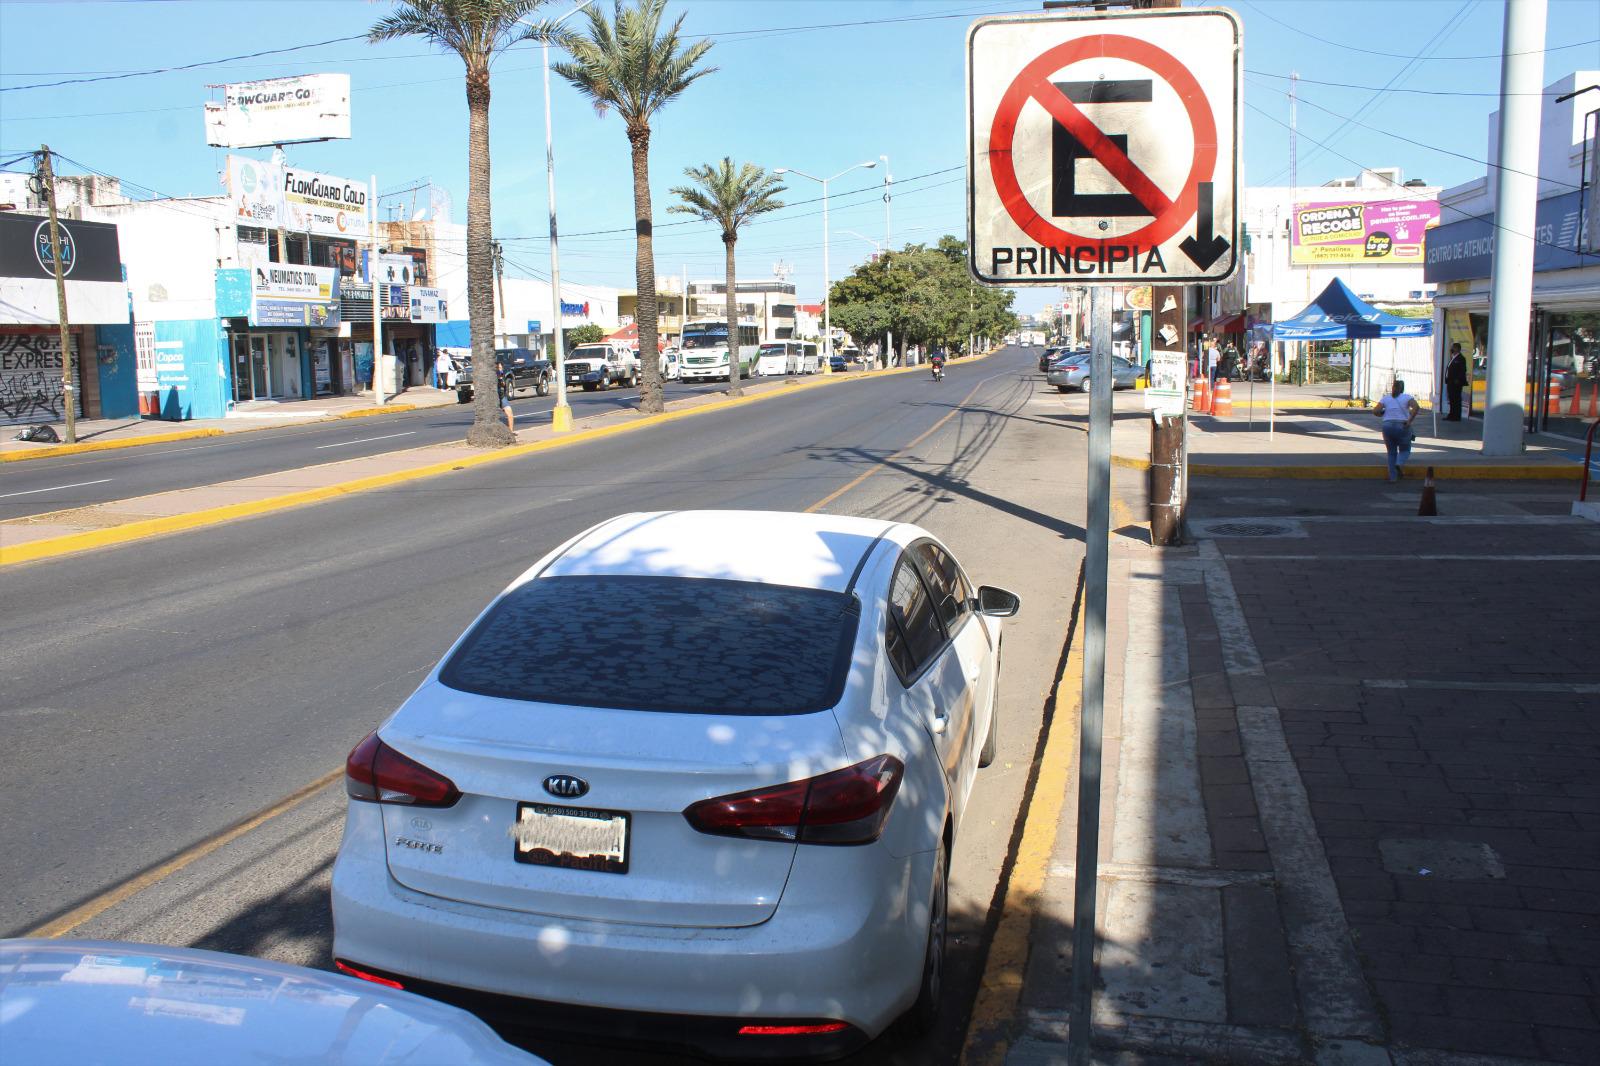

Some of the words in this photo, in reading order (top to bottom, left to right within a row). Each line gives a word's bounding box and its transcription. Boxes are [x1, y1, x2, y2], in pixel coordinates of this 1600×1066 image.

[314, 213, 334, 224] TRUPER
[1301, 207, 1349, 223] ORDENA
[1352, 207, 1361, 217] Y
[1302, 218, 1361, 235] RECOGE
[39, 234, 69, 245] SUHI
[1369, 236, 1390, 244] Pana
[1377, 243, 1389, 251] go
[40, 243, 71, 260] KM
[1428, 246, 1452, 265] CENTRO
[1453, 242, 1463, 260] DE
[1464, 232, 1495, 257] ATENCIÓ
[991, 245, 1167, 275] PRINCIPIA
[270, 269, 302, 285] NEUMATICS
[304, 272, 318, 286] TOOL
[1324, 313, 1381, 323] telcel
[548, 780, 582, 795] KIA
